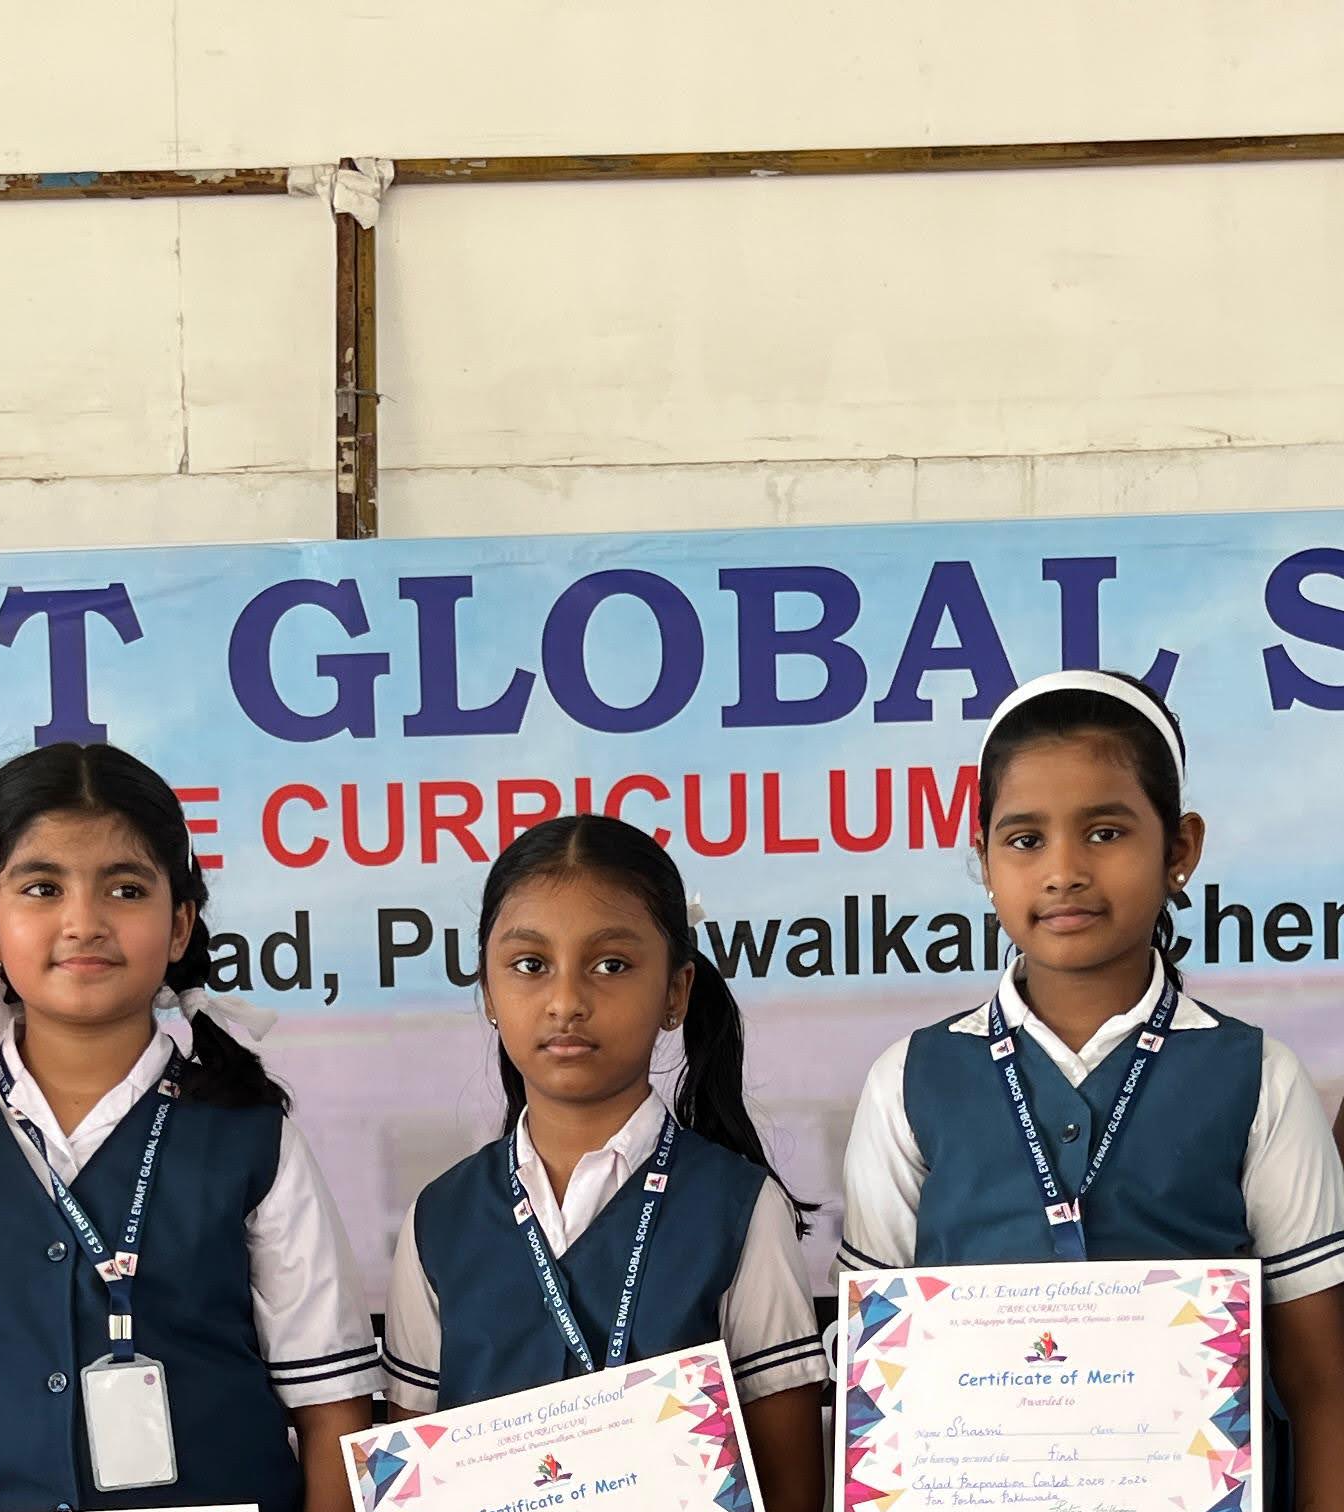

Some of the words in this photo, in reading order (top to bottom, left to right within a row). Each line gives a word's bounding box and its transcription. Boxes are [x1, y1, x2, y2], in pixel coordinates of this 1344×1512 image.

[227, 556, 1180, 742] GLOBAL
[207, 911, 339, 1006] ad,
[1005, 1062, 1024, 1104] SCHOOL
[1016, 1102, 1038, 1140] GLOBAL
[1092, 1131, 1113, 1169] EWART
[1108, 1096, 1131, 1133] GLOBAL
[1123, 1057, 1147, 1097] SCHOOL
[131, 1176, 148, 1215] EWART
[140, 1138, 159, 1179] GLOBAL
[150, 1103, 172, 1139] SCHOOL
[1029, 1136, 1050, 1173] EWART
[63, 1197, 89, 1230] EWART
[527, 1225, 547, 1267] SCHOOL
[616, 1288, 633, 1329] EWART
[625, 1245, 644, 1288] GLOBAL
[635, 1199, 655, 1243] SCHOOL
[542, 1266, 564, 1310] GLOBAL
[995, 1285, 1040, 1298] Ewart
[1045, 1281, 1093, 1301] Global
[1094, 1280, 1144, 1297] School
[557, 1309, 579, 1347] EWART
[958, 1371, 1052, 1387] Certificate
[1060, 1370, 1078, 1385] of
[1086, 1369, 1136, 1384] Merit
[490, 1411, 533, 1433] Ewart
[537, 1397, 580, 1424] Global
[583, 1385, 625, 1410] School
[1017, 1396, 1064, 1408] Awarded
[1065, 1397, 1076, 1406] to
[1136, 1423, 1150, 1434] IV
[571, 1483, 587, 1500] of
[596, 1472, 638, 1496] Merit
[912, 1475, 953, 1490] Salad
[960, 1472, 1025, 1489] Preparation
[1033, 1472, 1070, 1488] Contest
